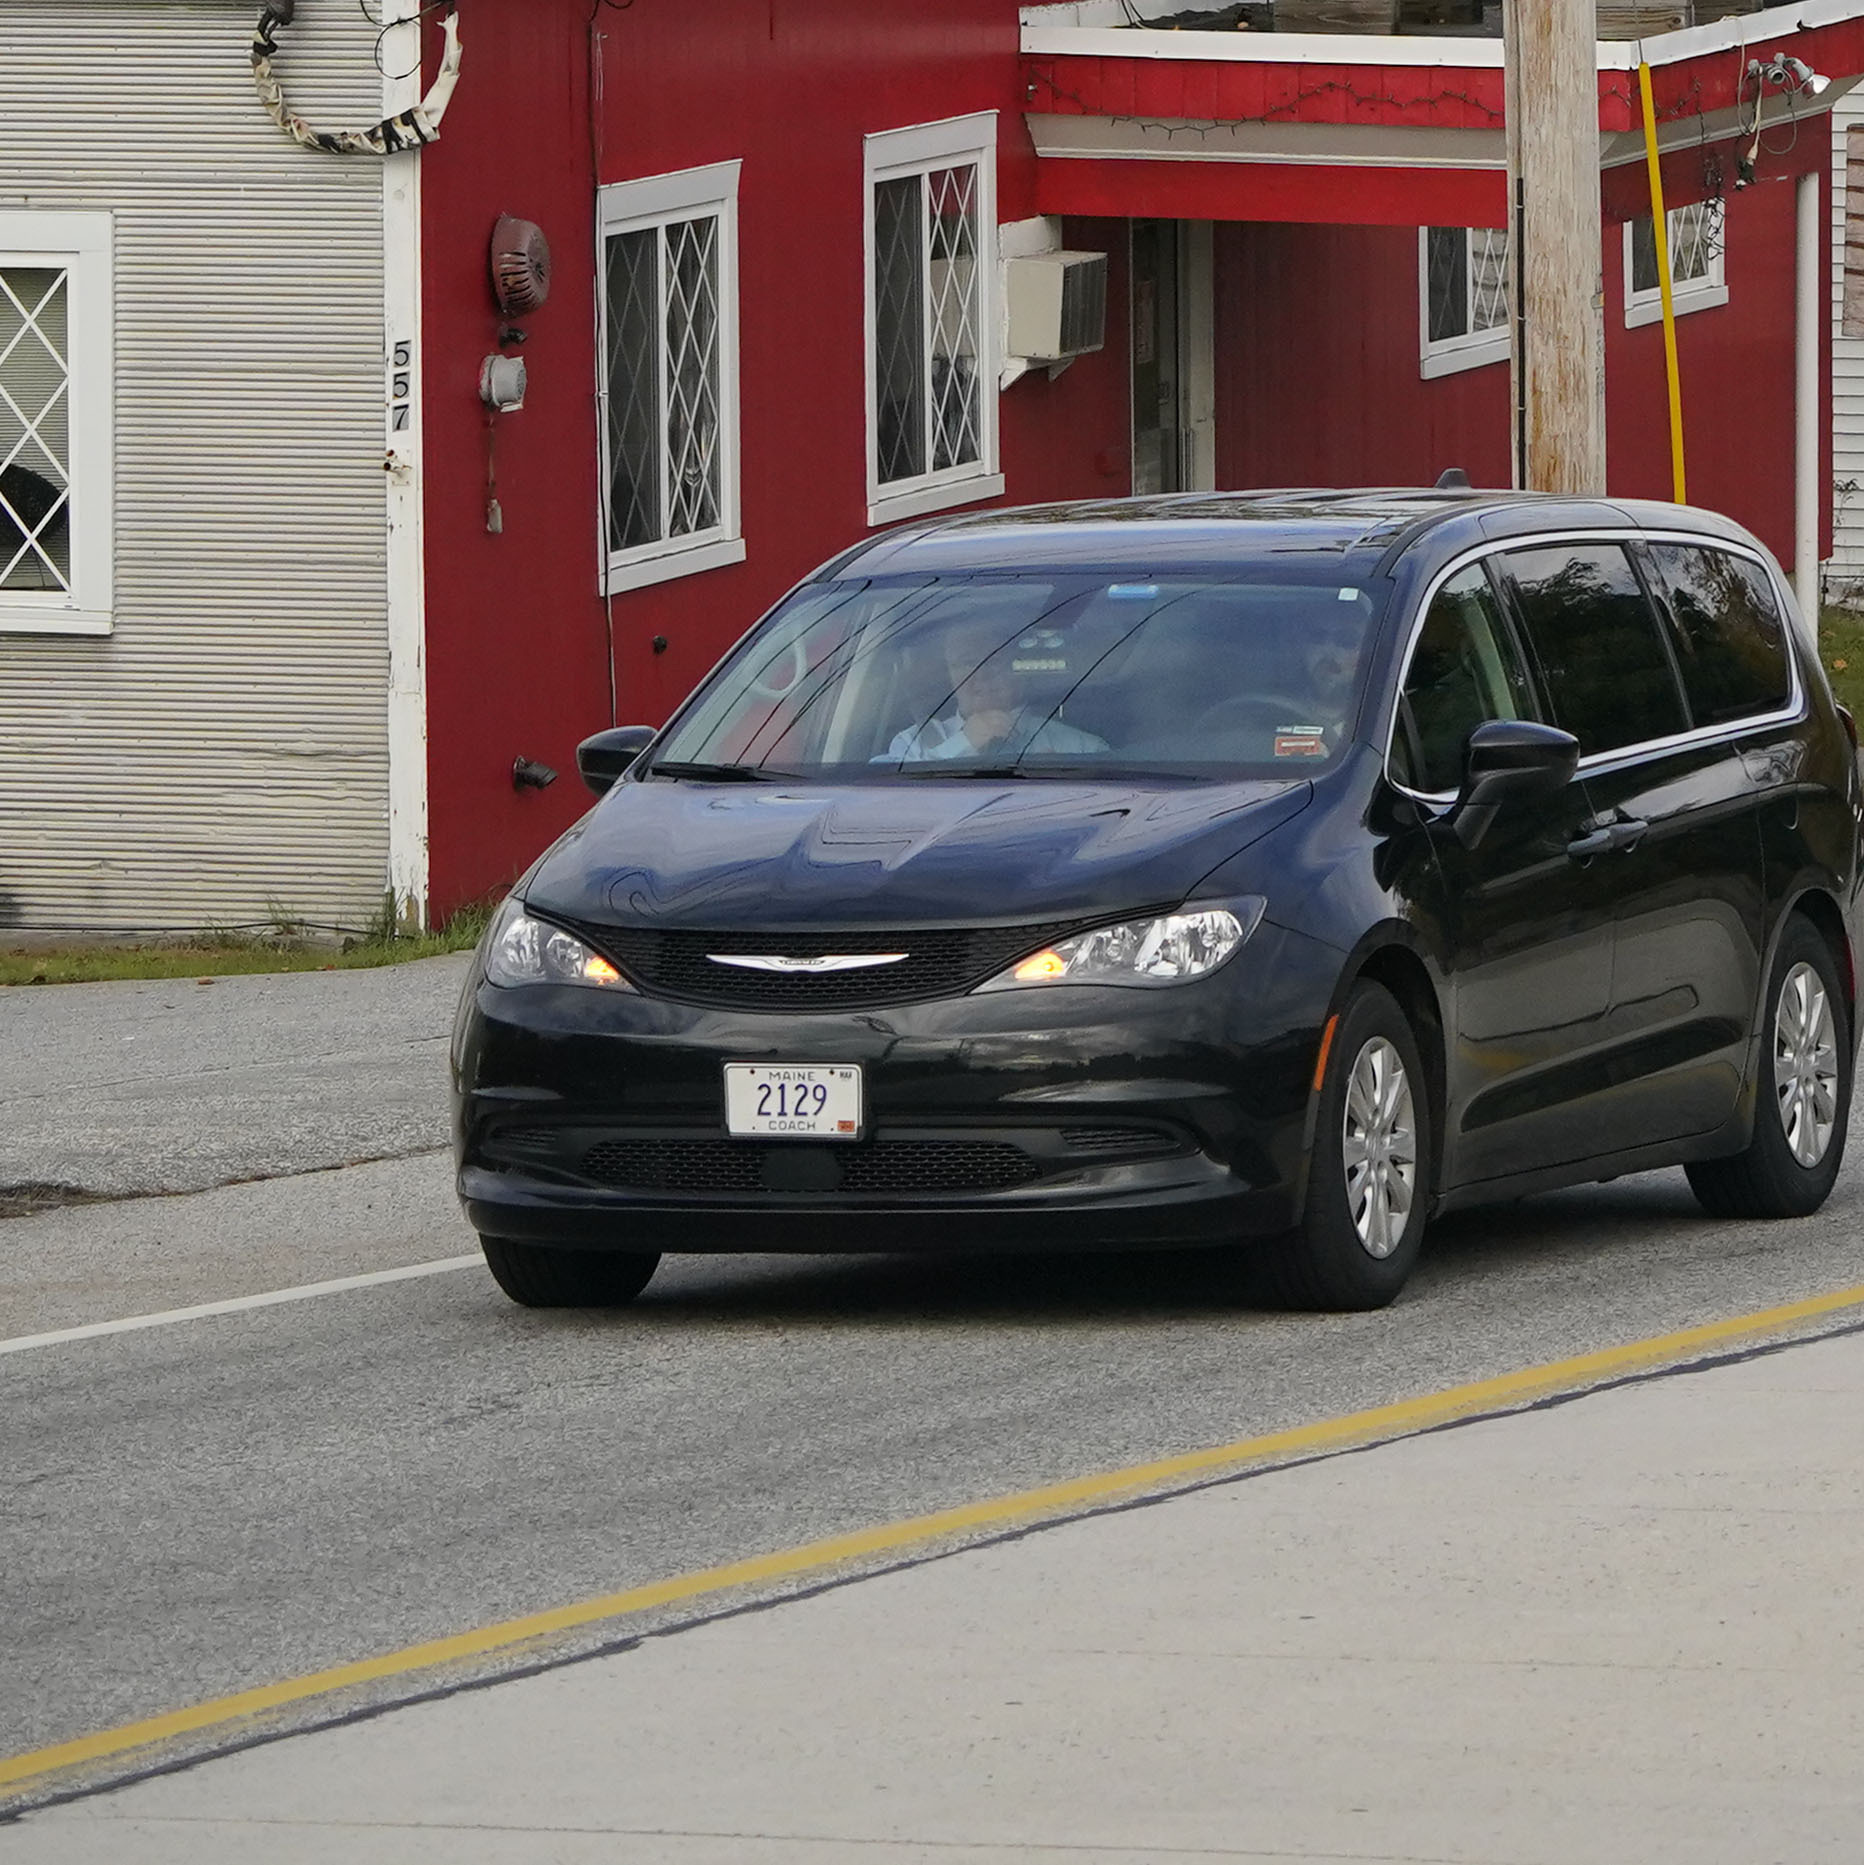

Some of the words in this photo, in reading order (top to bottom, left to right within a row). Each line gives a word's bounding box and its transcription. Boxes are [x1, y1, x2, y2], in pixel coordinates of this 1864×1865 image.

[394, 340, 411, 431] 557
[768, 1071, 816, 1082] MAINE
[757, 1083, 827, 1116] 2129
[768, 1121, 816, 1131] COACH
